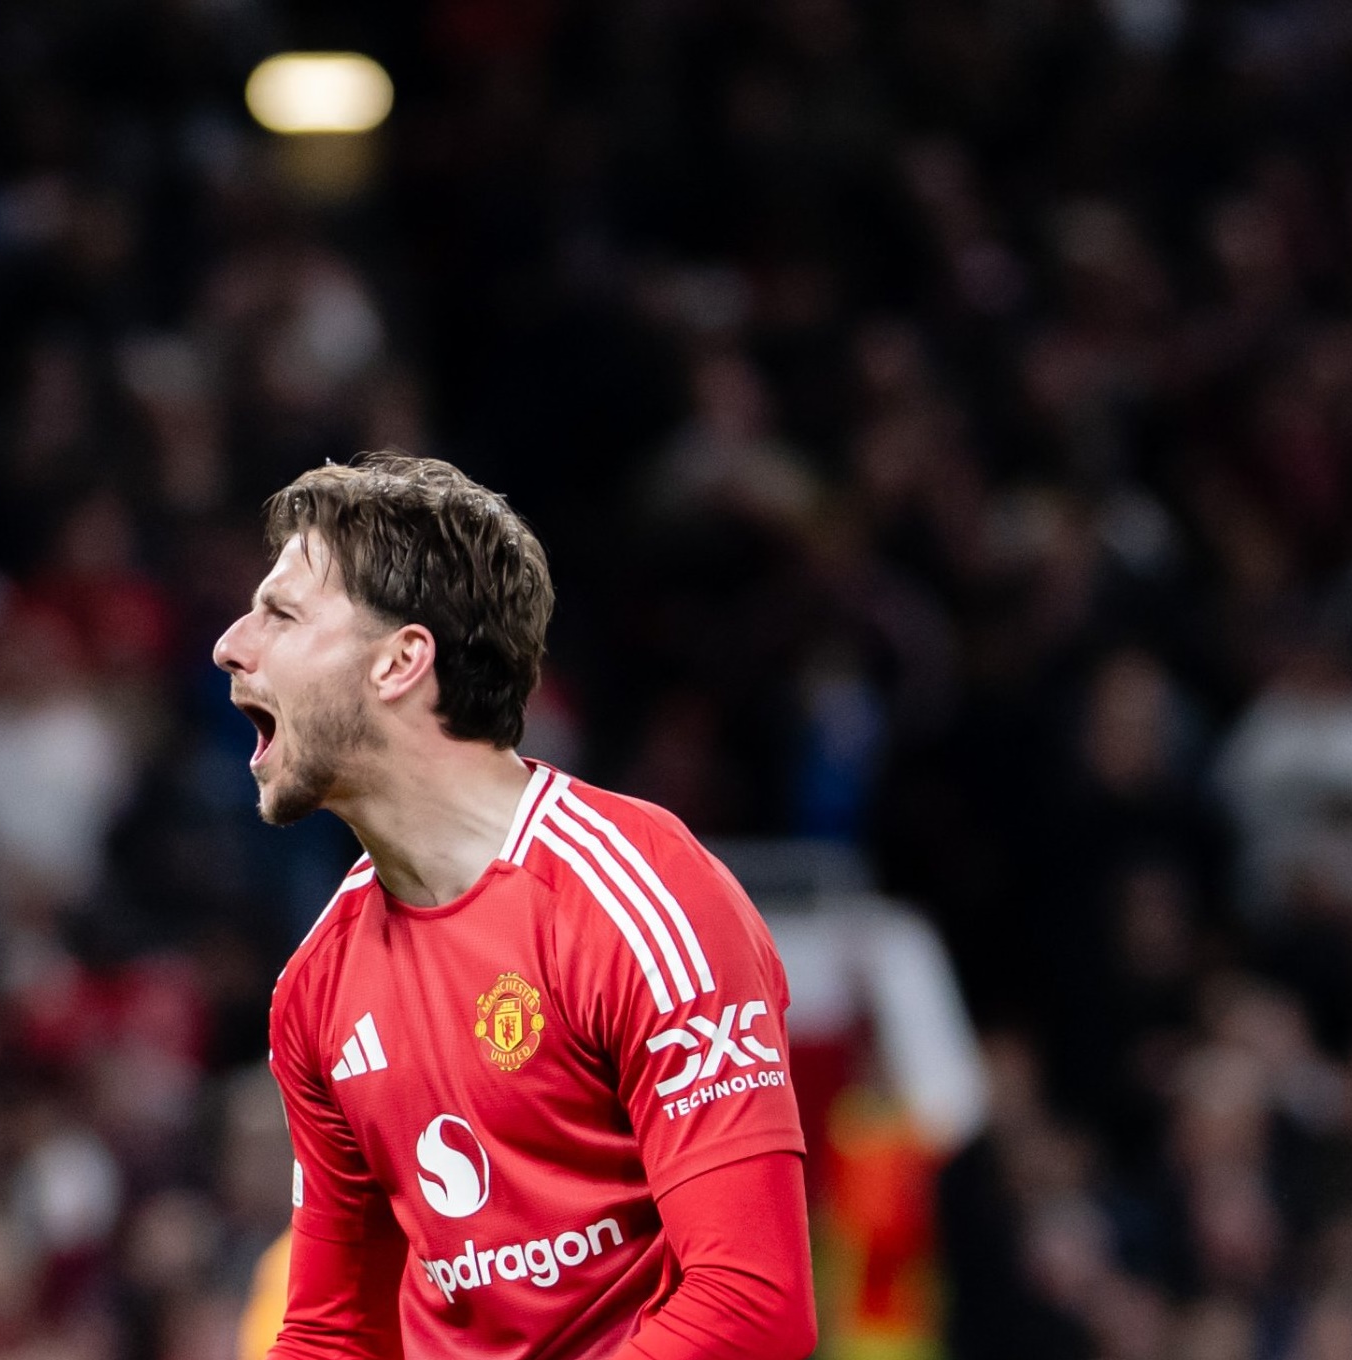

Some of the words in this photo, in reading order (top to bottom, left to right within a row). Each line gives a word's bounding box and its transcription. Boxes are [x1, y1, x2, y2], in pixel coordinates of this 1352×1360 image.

[481, 981, 537, 1013] MANCHESTER
[490, 1046, 532, 1064] UNITED
[645, 1000, 781, 1098] DXC
[663, 1070, 786, 1120] TECHNOLOGY
